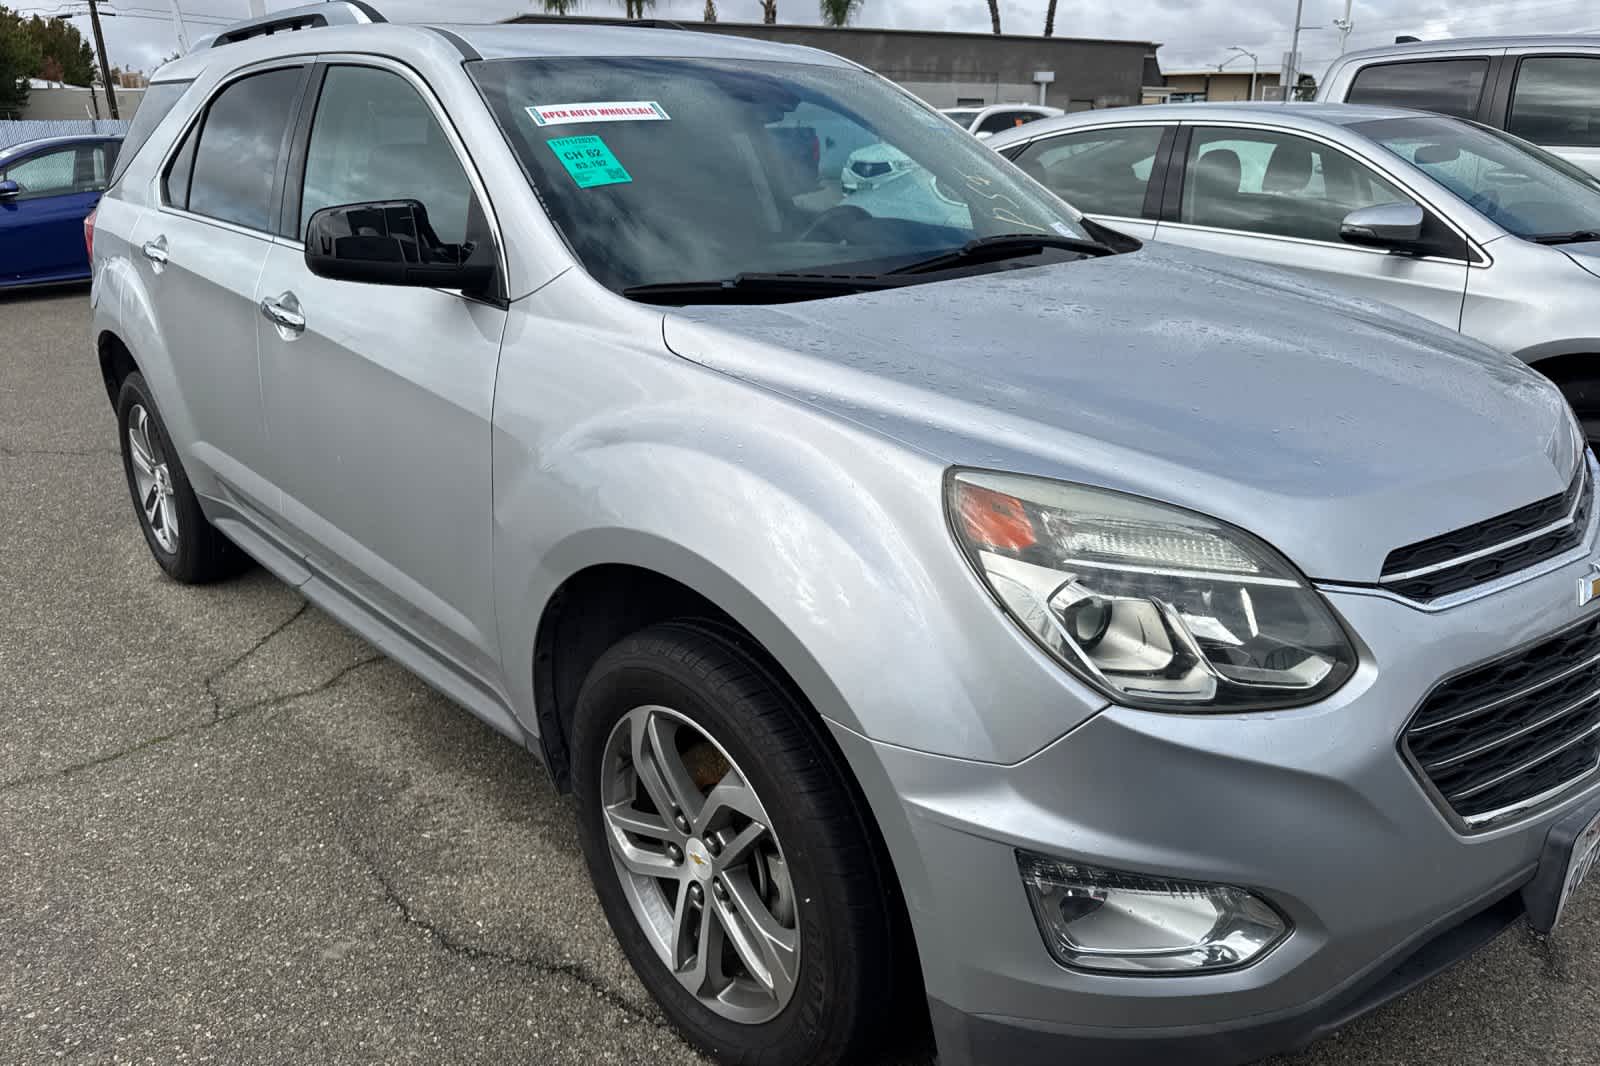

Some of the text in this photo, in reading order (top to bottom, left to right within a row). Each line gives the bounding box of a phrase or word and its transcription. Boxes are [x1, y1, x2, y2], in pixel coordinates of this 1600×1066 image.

[541, 110, 568, 119] APEX
[570, 109, 598, 117] AUTO
[599, 107, 657, 116] WHOLESALE
[563, 148, 603, 160] CH 62
